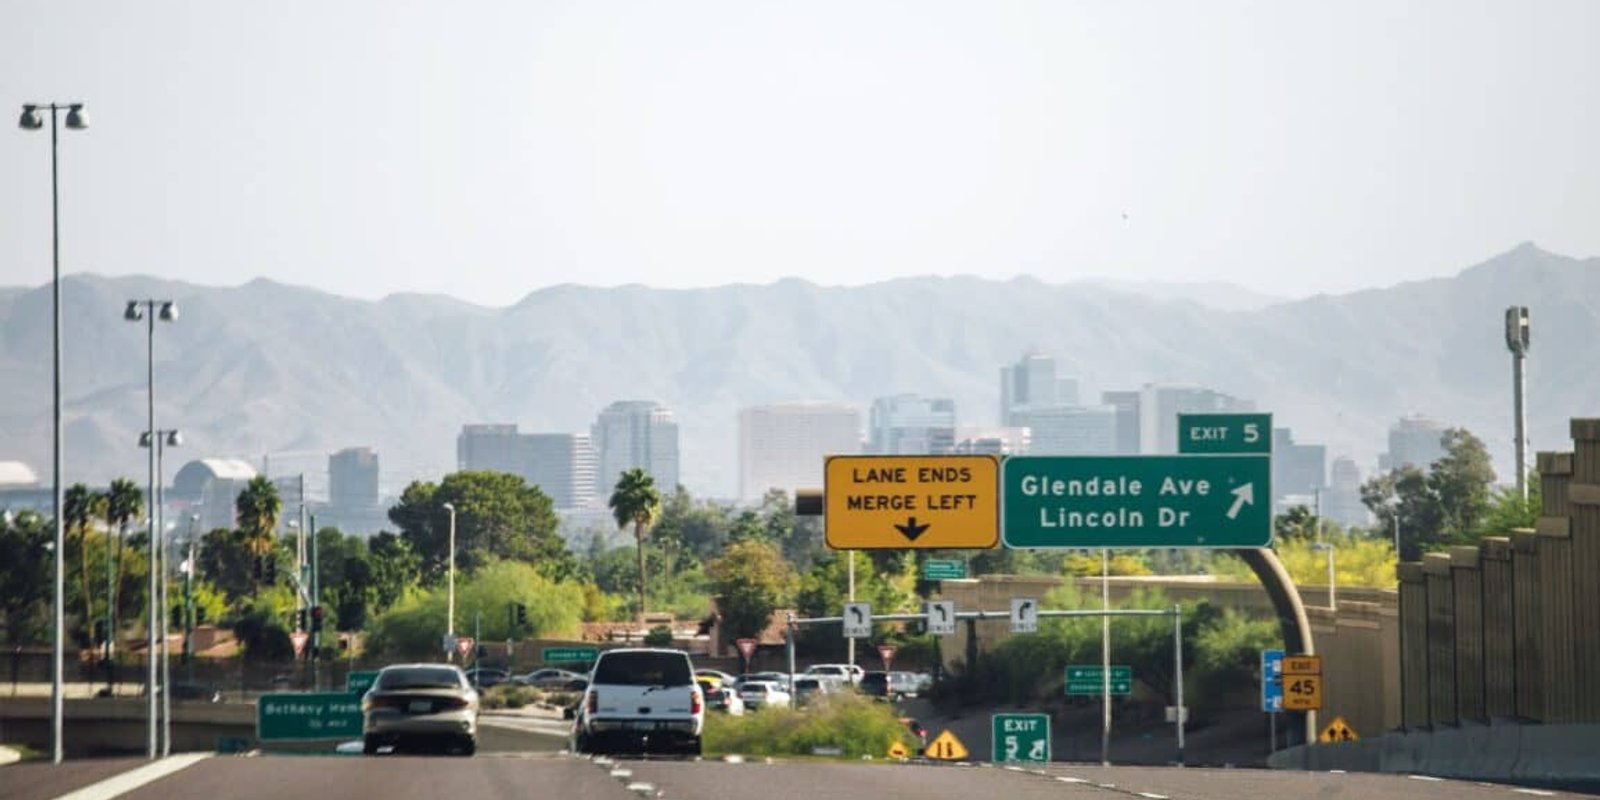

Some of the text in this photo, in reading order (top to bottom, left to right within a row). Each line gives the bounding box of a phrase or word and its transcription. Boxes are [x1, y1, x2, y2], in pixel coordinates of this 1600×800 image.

[1190, 423, 1259, 443] EXIT 5
[852, 467, 972, 483] LANE ENDS
[1020, 475, 1211, 496] Glendale Ave
[847, 494, 977, 510] MERGE LEFT
[1040, 507, 1190, 528] Lincoln Dr
[1290, 680, 1315, 695] 45
[329, 702, 361, 714] Hom
[1004, 719, 1038, 732] EXIT
[1005, 735, 1019, 754] 5
